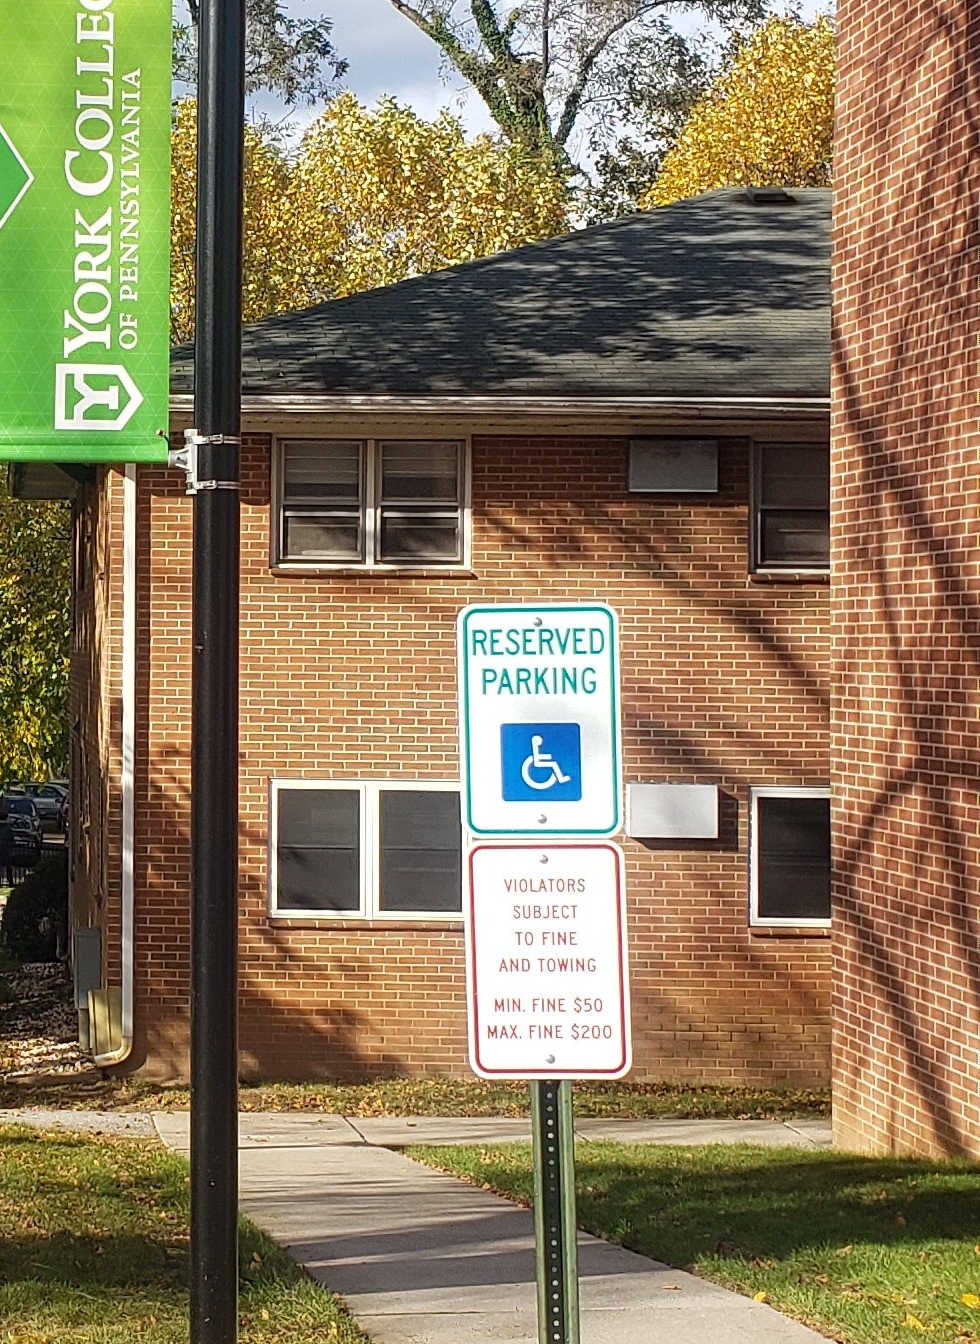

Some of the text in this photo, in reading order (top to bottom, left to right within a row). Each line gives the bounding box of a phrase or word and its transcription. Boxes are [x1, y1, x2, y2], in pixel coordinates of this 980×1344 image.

[119, 67, 142, 350] OF PENNSYLVANIA
[63, 206, 113, 359] YORK
[471, 626, 606, 657] RESERVED
[481, 666, 597, 696] PARKING
[503, 878, 586, 893] VIOLATORS
[512, 904, 578, 920] SUBJECT
[514, 931, 578, 946] TO FINE
[498, 957, 597, 973] AND TOWING
[494, 996, 603, 1014] MIN. FINE $50
[486, 1022, 612, 1041] MAX. FINE $200
